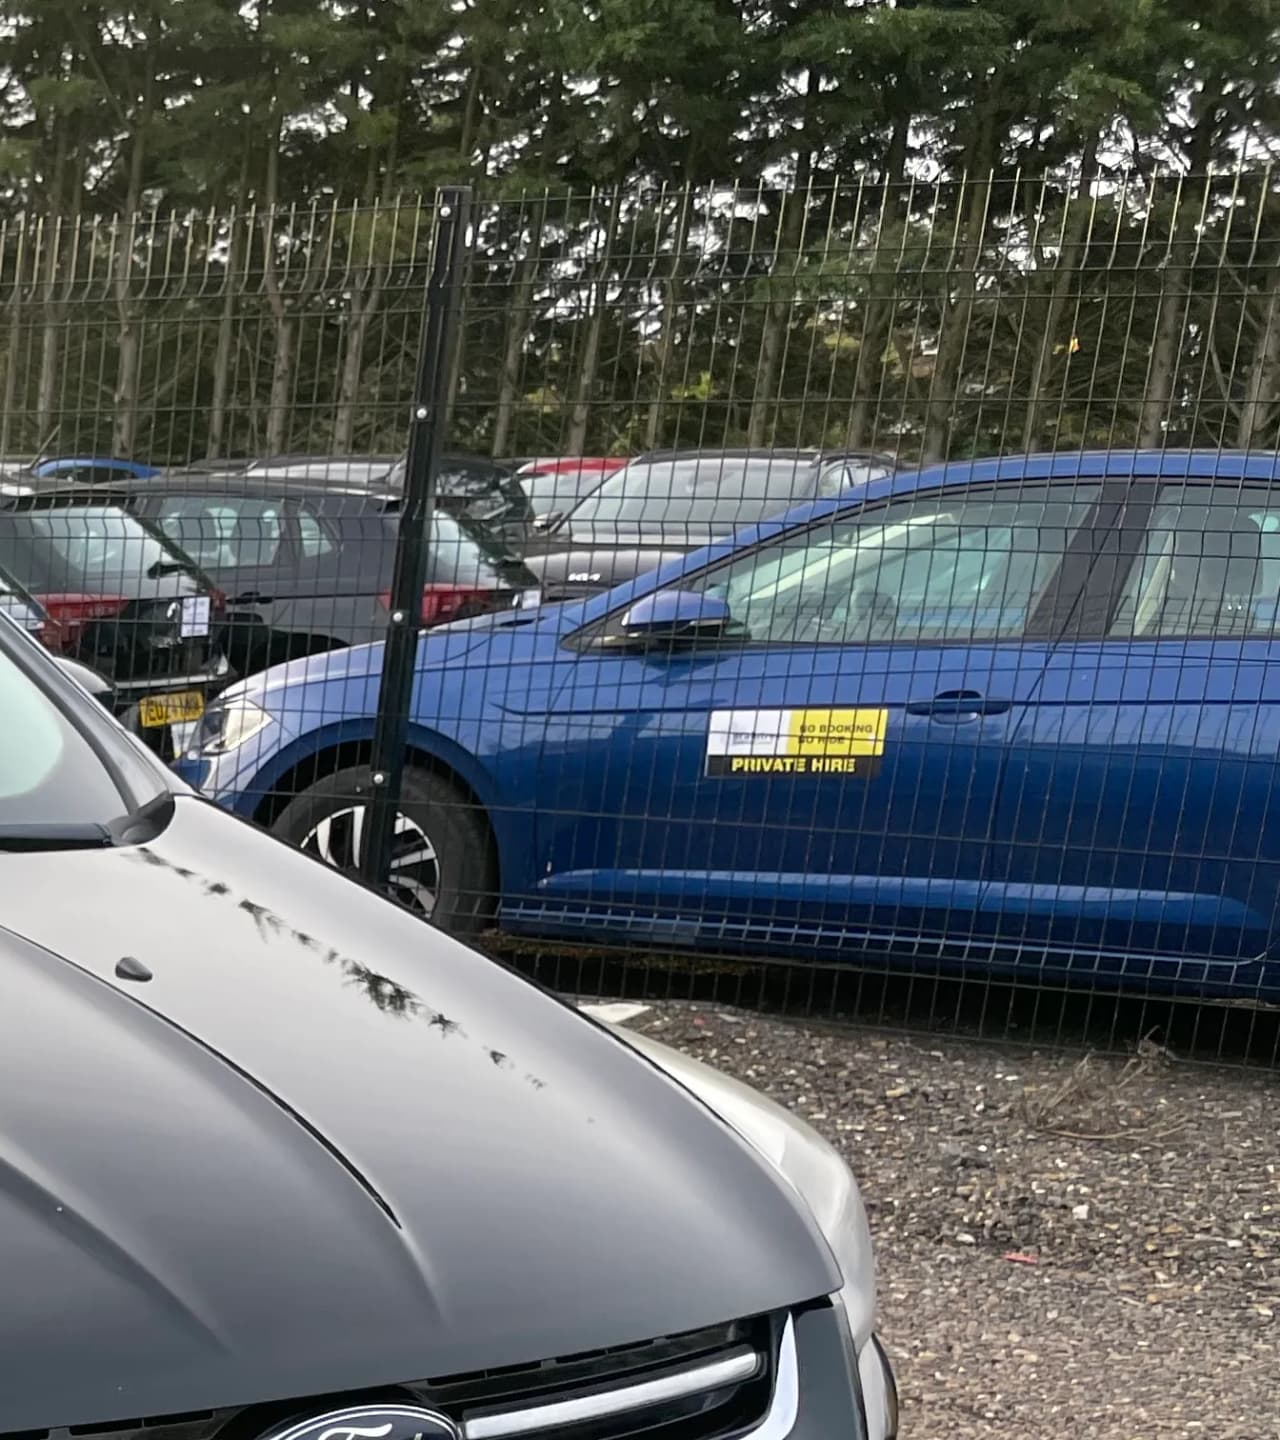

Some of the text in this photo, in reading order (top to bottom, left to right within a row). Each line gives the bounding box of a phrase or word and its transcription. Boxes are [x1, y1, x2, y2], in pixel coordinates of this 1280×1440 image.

[818, 724, 873, 734] BOOKING
[731, 757, 856, 773] PRIVATE HIRE
